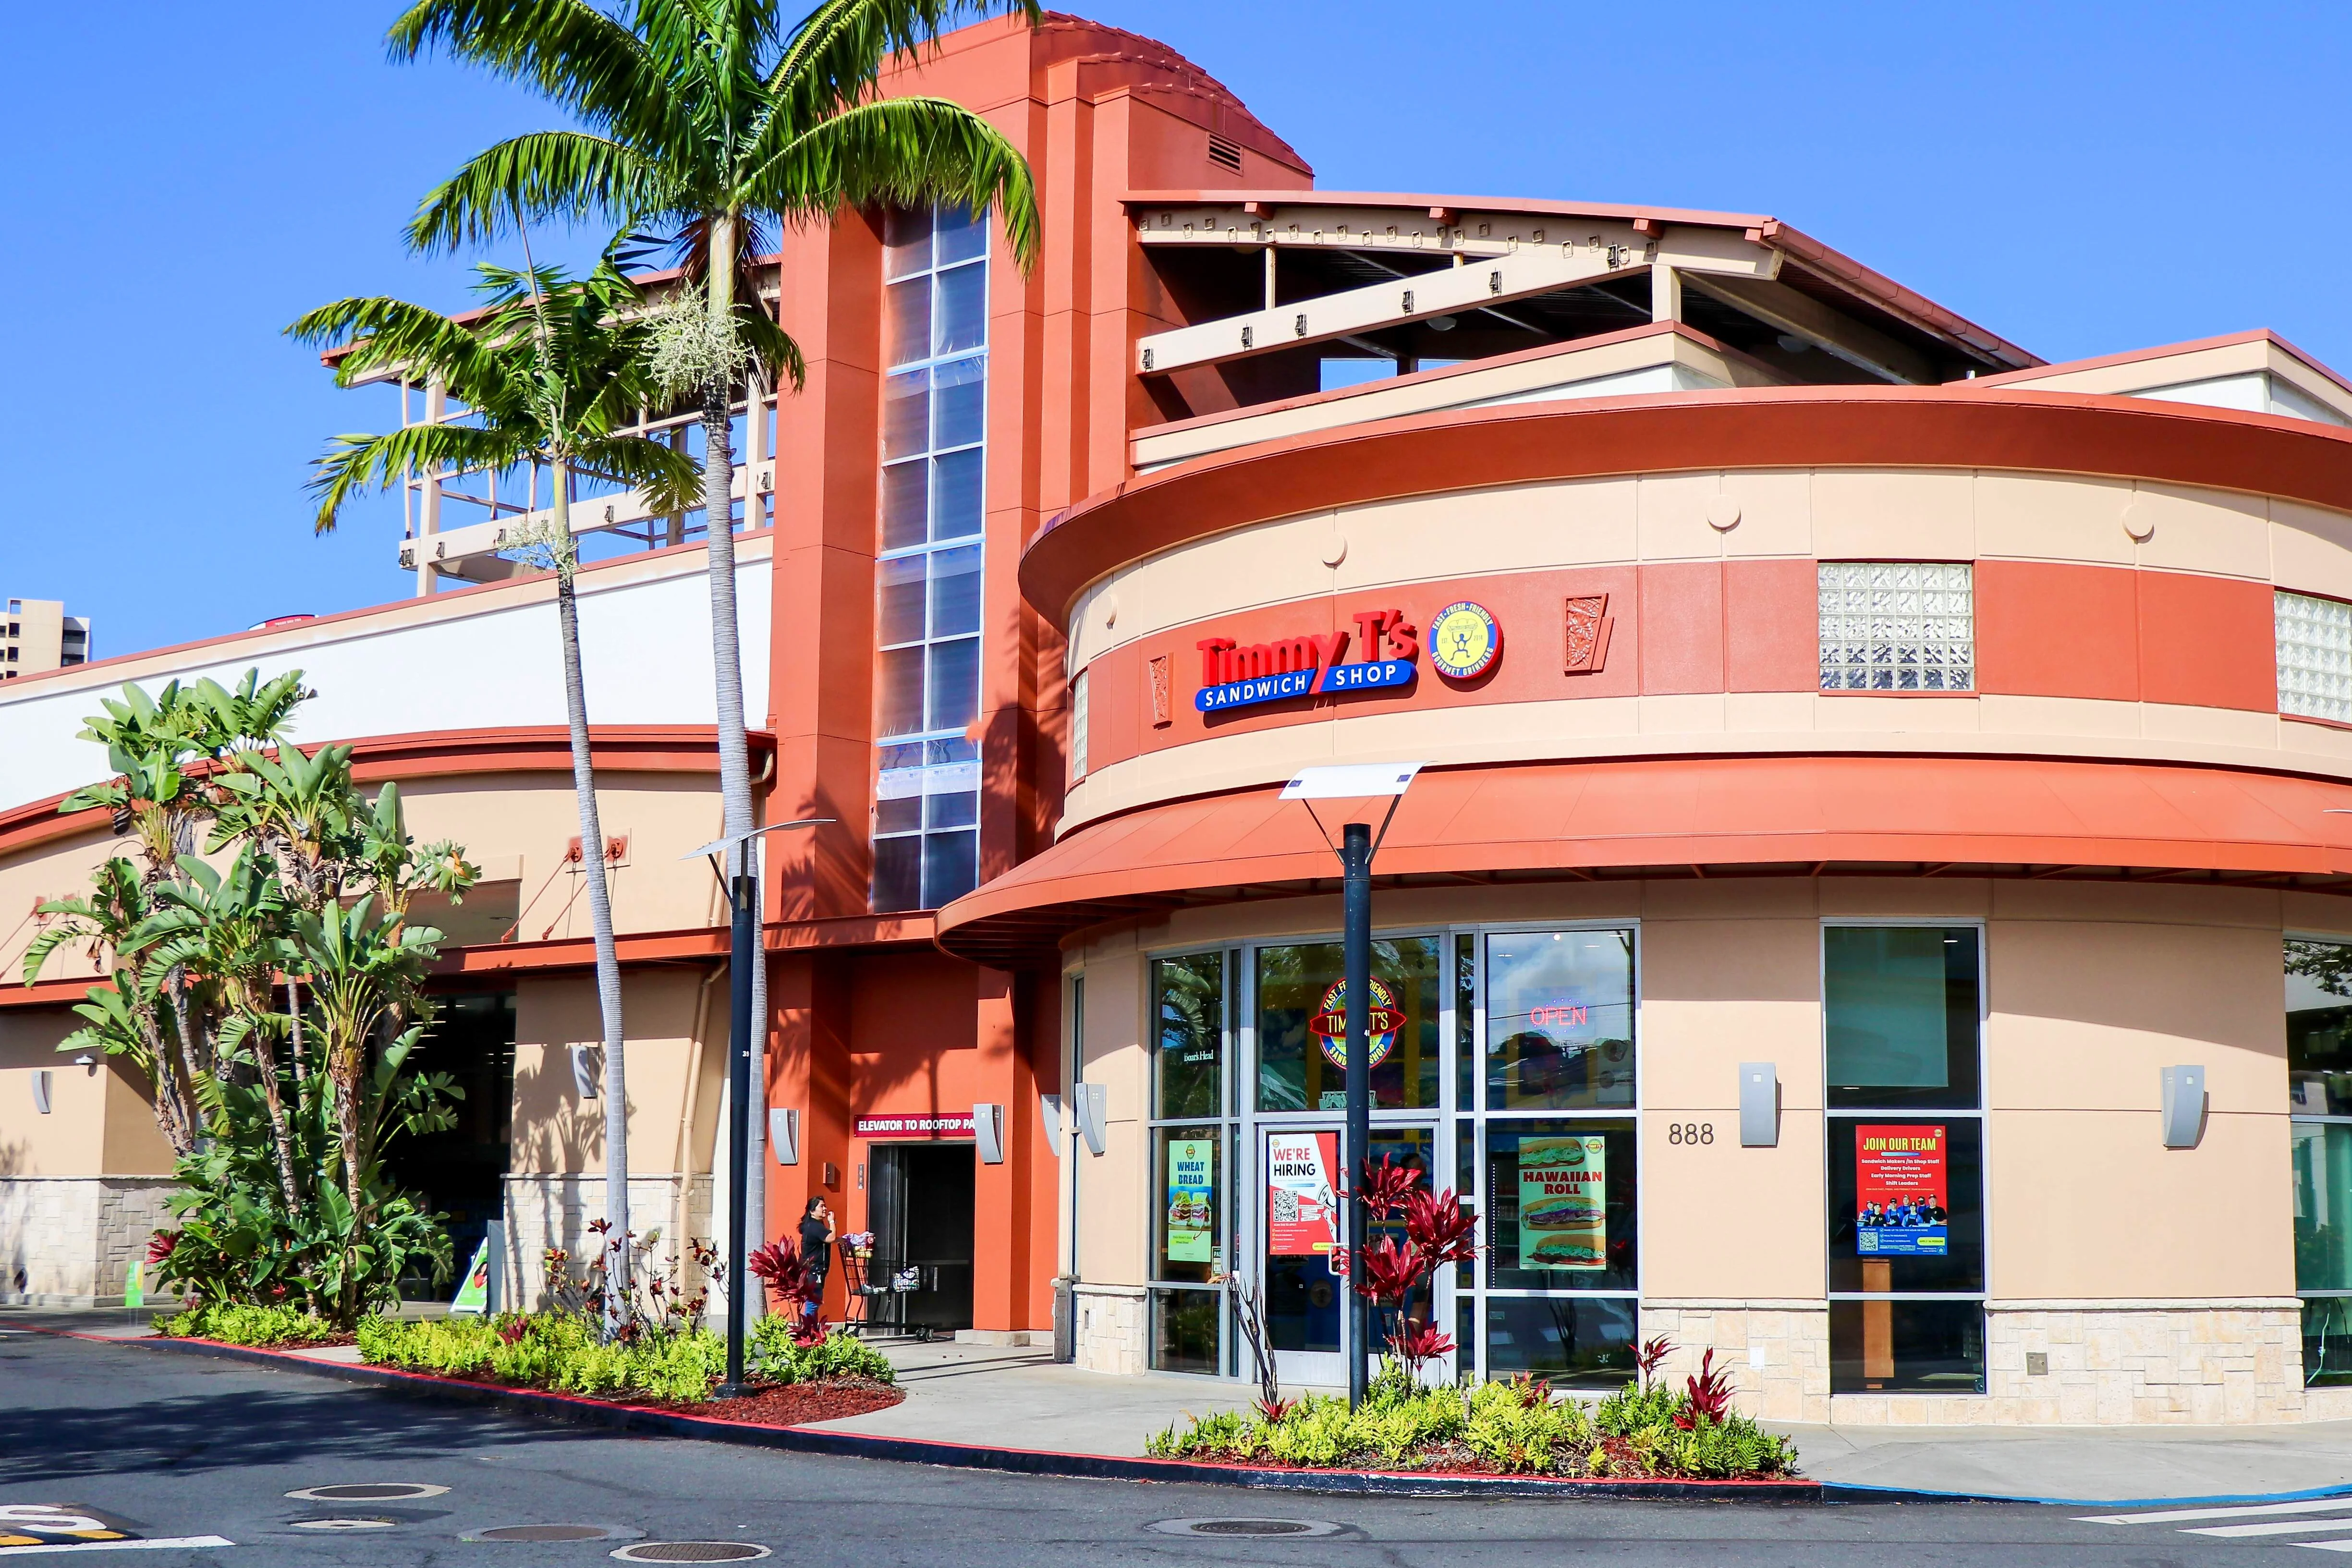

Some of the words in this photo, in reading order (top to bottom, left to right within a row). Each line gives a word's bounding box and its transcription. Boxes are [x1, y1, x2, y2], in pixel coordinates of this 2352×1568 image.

[1432, 612, 1445, 630] FAST
[1446, 603, 1465, 615] FRESH
[1469, 603, 1493, 625] FRIENDLY
[1196, 631, 1349, 694] Timmy
[1353, 609, 1417, 662] T's
[1432, 651, 1460, 676] GOURMET
[1463, 647, 1494, 676] GRINDERS
[1205, 675, 1305, 707] SANDWICH
[1335, 664, 1397, 686] SHOP
[1324, 989, 1338, 1010] FAST
[1369, 979, 1392, 1006] RIENDLY
[1326, 1015, 1346, 1033] TIM
[1369, 1011, 1389, 1030] T'S
[1530, 1007, 1587, 1025] OPEN
[1199, 1049, 1214, 1061] Head
[1329, 1046, 1347, 1066] SAND
[1369, 1044, 1386, 1064] SHOP
[858, 1119, 903, 1131] ELEVATOR
[905, 1119, 918, 1130] TO
[919, 1119, 962, 1130] ROOFTOP
[963, 1118, 975, 1130] PA
[1669, 1123, 1714, 1145] 888
[1863, 1137, 1887, 1151] JOIN
[1889, 1137, 1908, 1151] OUR
[1910, 1137, 1937, 1151] TEAM
[1273, 1147, 1310, 1161] WE'RE
[1177, 1161, 1205, 1171] WHEAT
[1274, 1163, 1316, 1176] HIRING
[1178, 1175, 1204, 1185] BREAD
[1523, 1171, 1602, 1182] HAWAIIAN
[1544, 1184, 1581, 1195] ROLL
